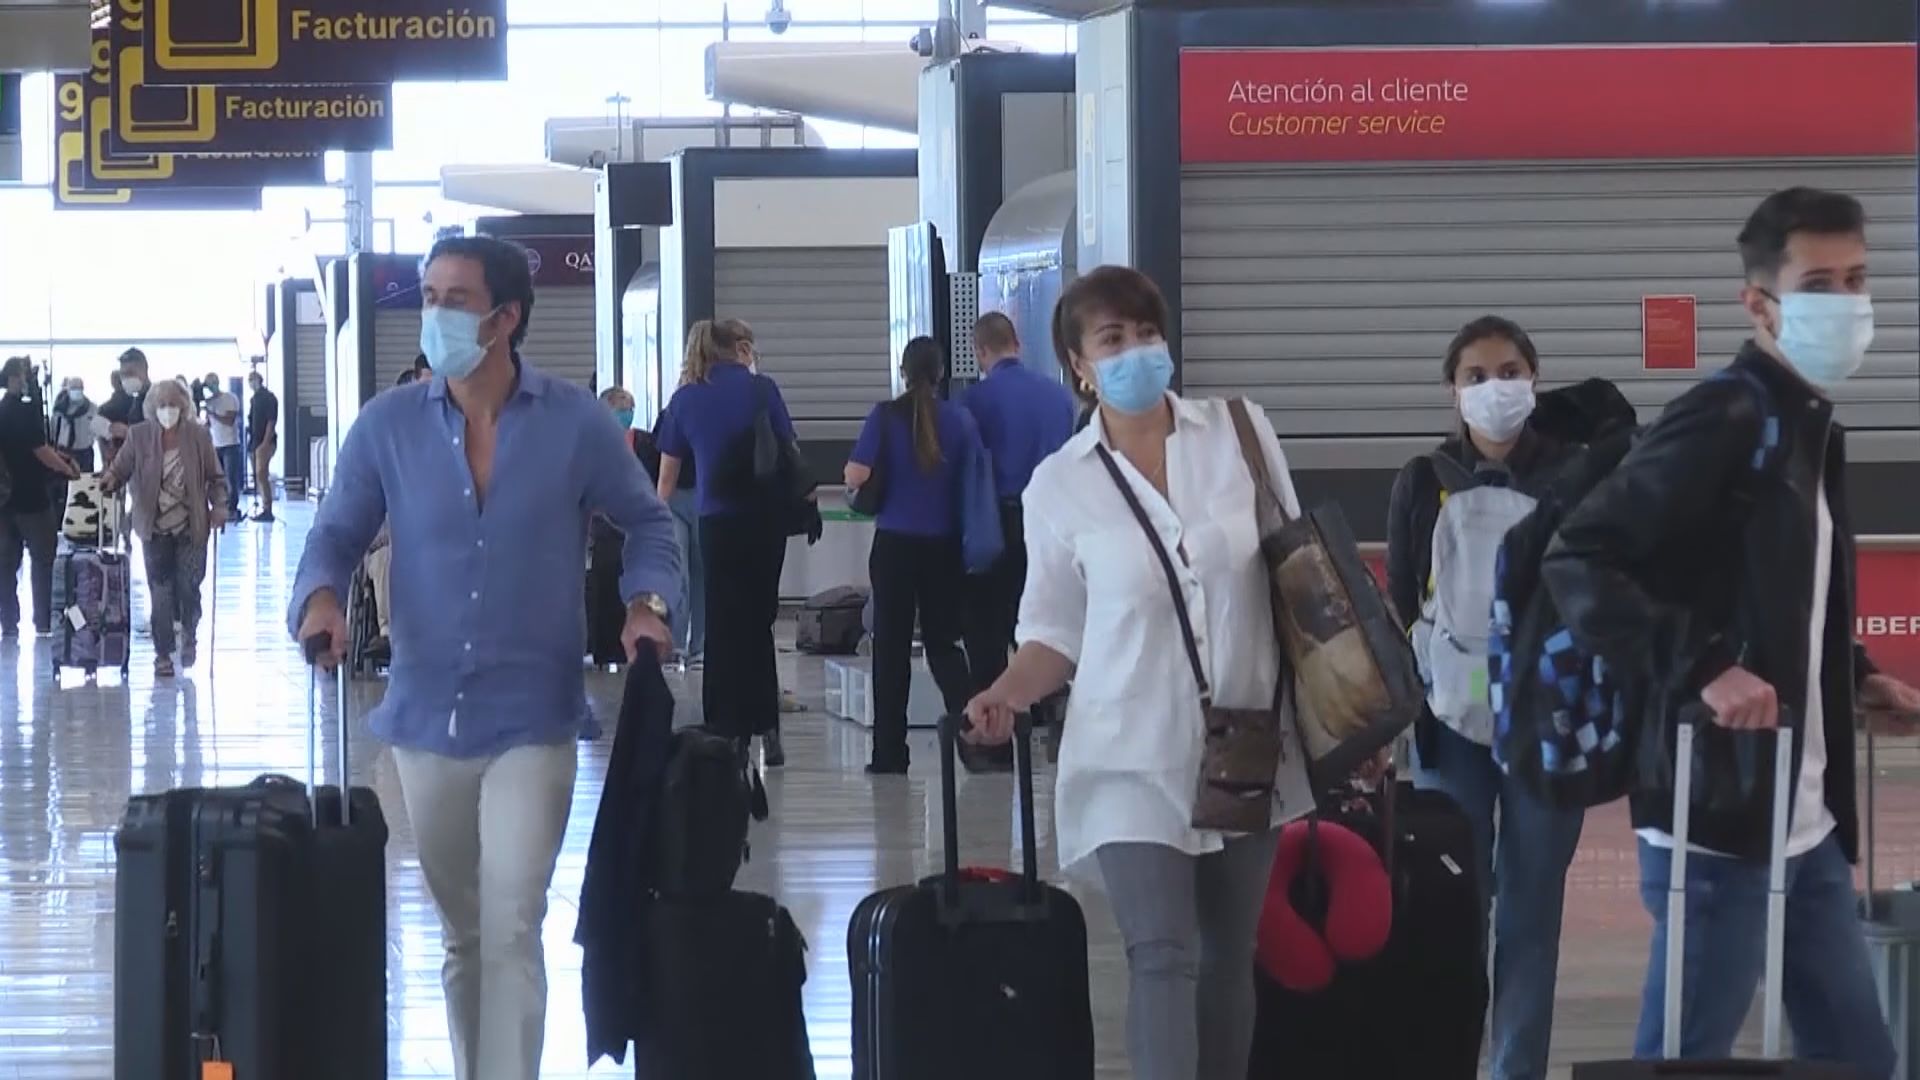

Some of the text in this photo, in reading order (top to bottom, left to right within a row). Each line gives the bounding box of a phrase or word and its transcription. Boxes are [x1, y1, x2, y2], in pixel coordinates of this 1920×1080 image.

[291, 8, 496, 40] Facturación
[58, 81, 83, 121] 9
[1228, 78, 1468, 103] Atención al cliente
[225, 94, 384, 119] Facturación
[1229, 110, 1445, 135] Customer service
[565, 252, 594, 269] QA
